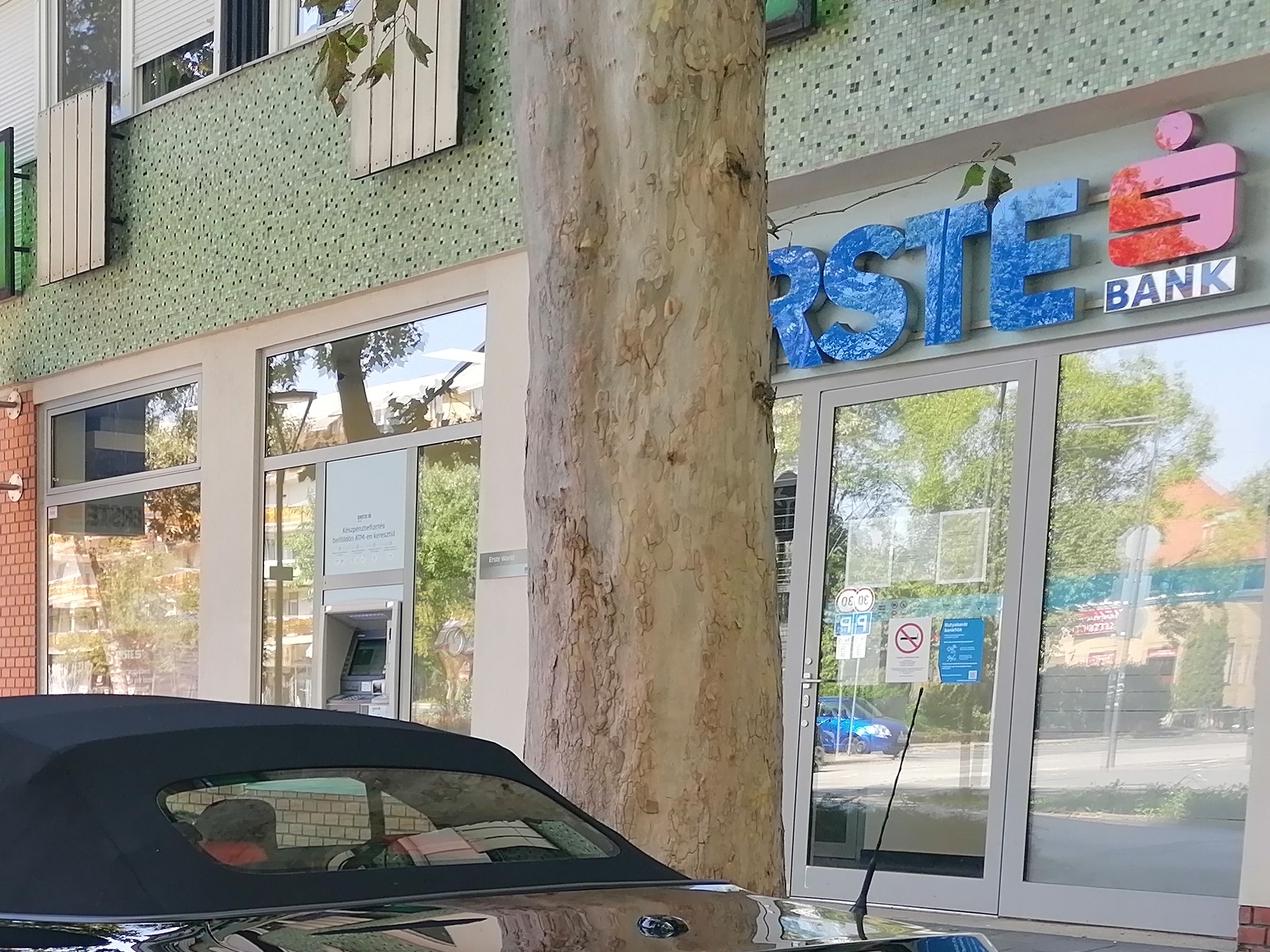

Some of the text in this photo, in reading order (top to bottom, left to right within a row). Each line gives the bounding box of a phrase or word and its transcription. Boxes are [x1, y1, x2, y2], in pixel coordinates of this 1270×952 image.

[768, 178, 1086, 369] RSTE
[1106, 259, 1232, 310] BANK
[501, 554, 515, 562] World
